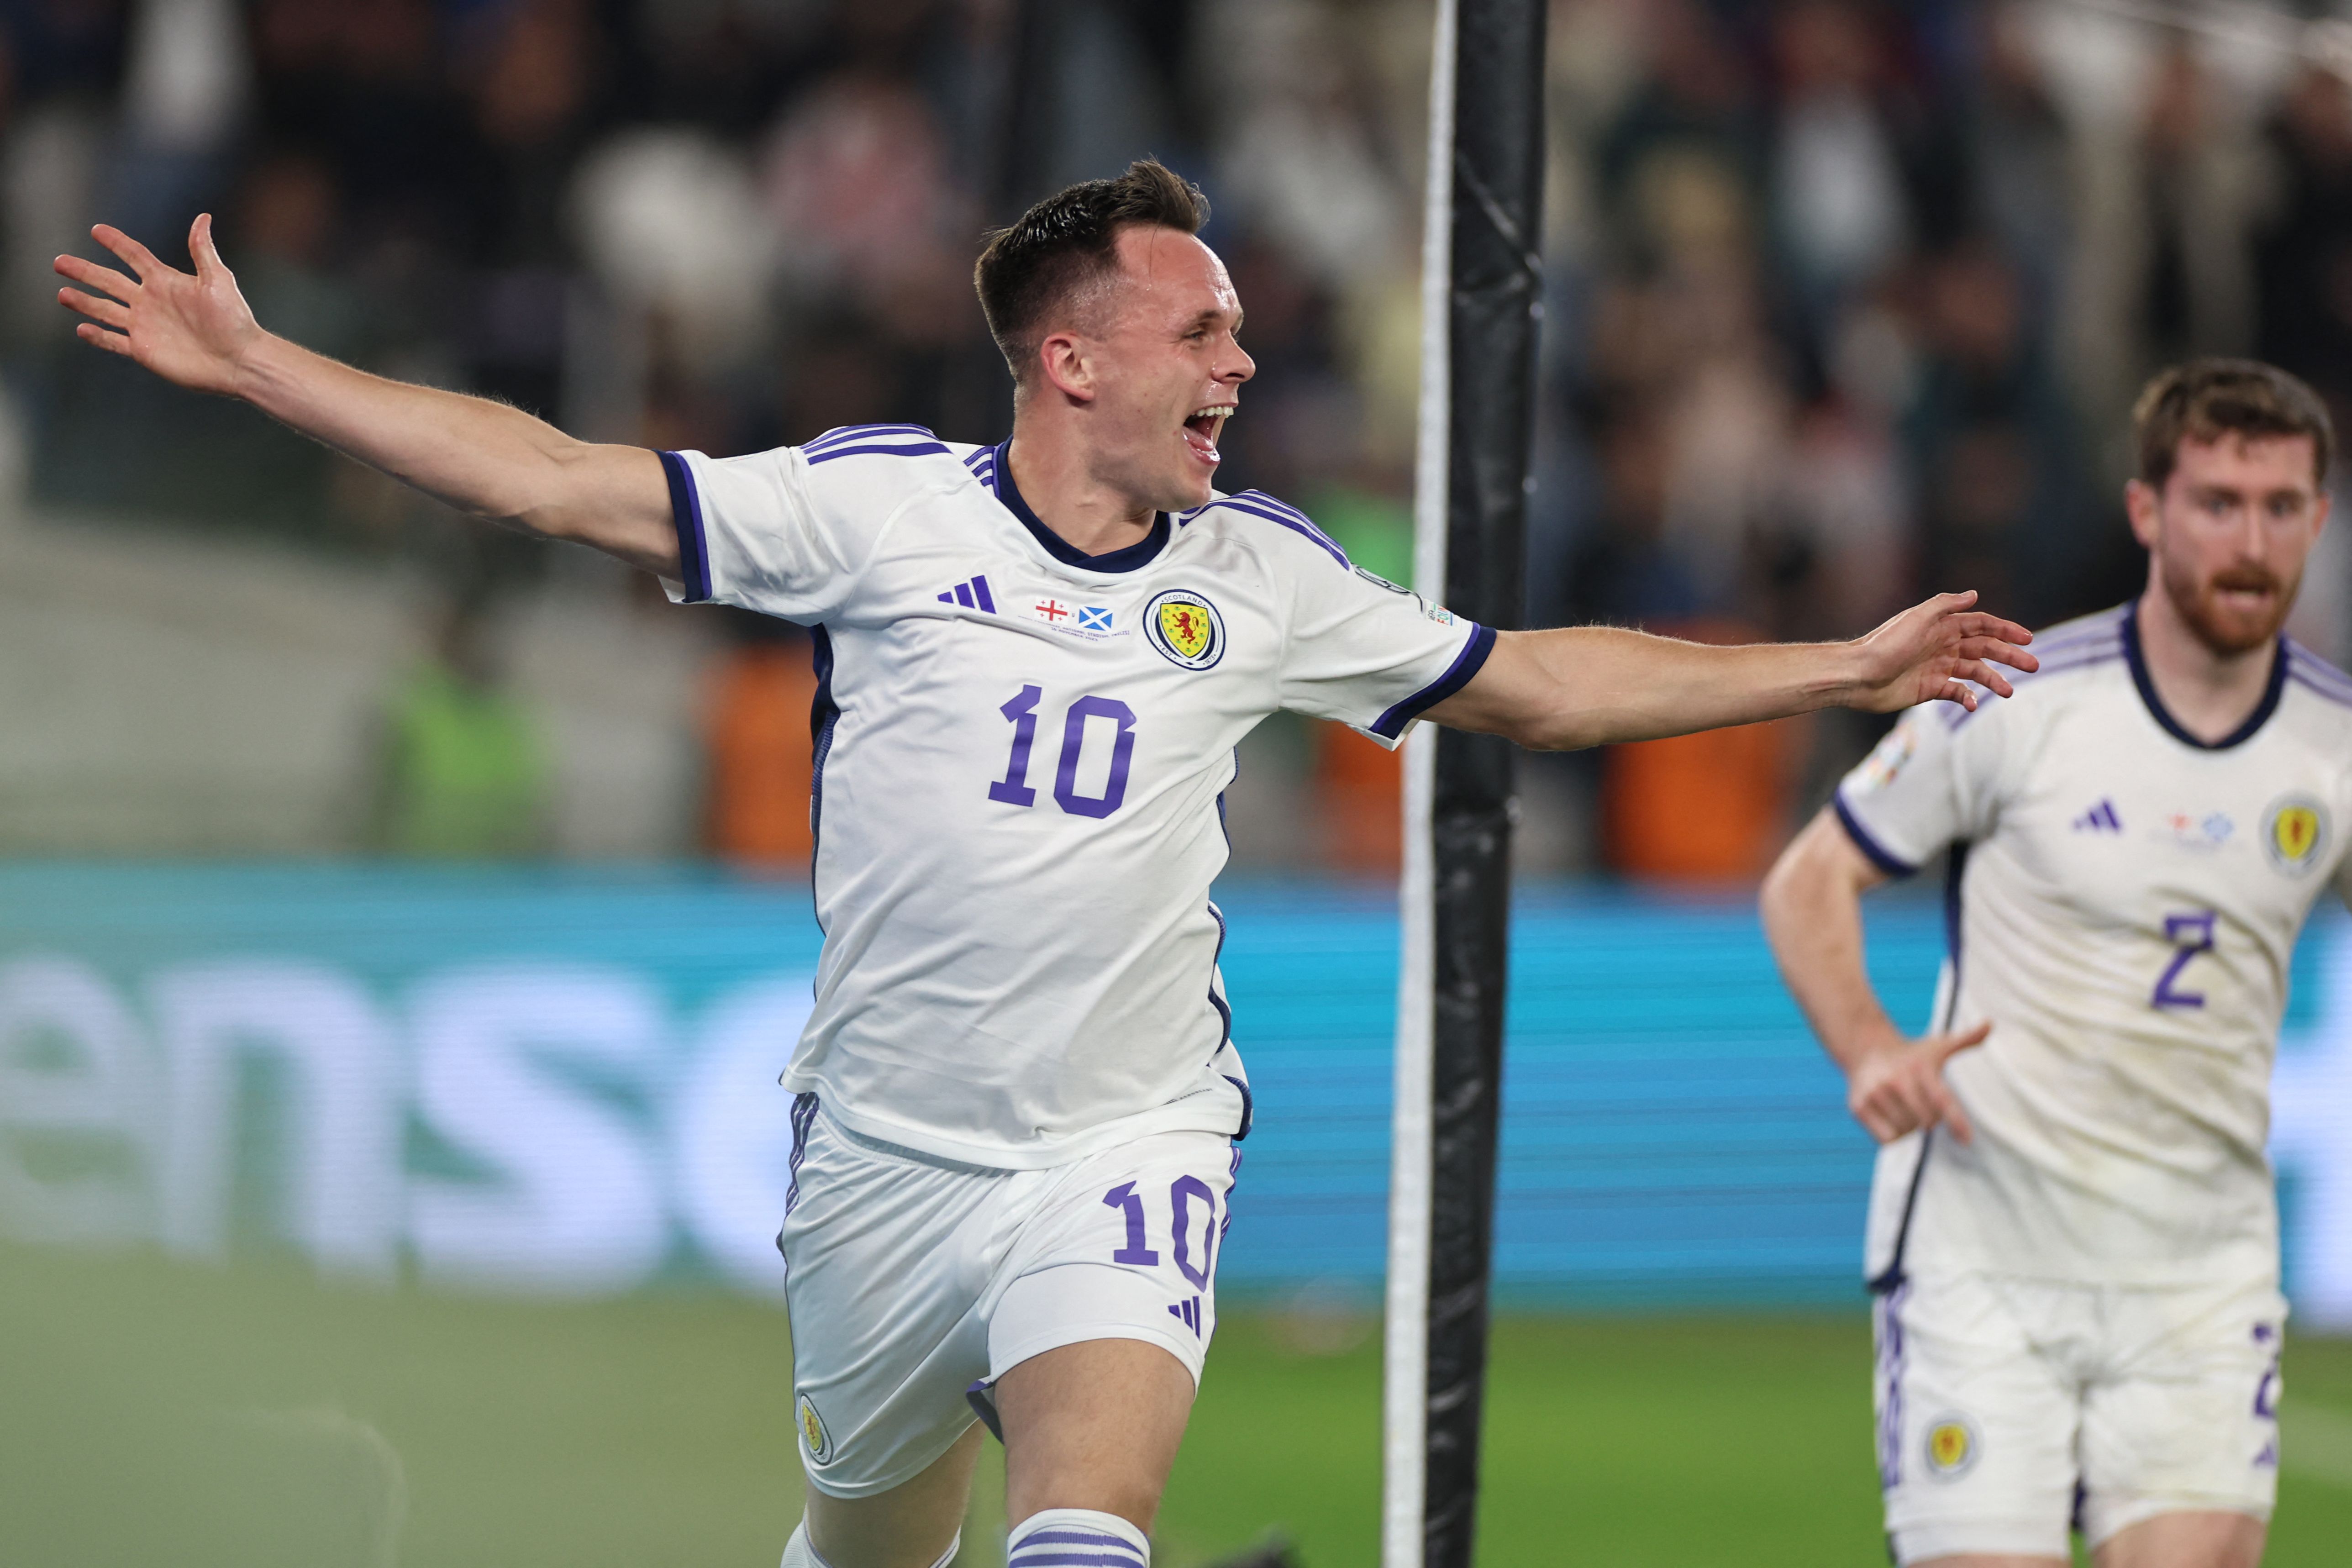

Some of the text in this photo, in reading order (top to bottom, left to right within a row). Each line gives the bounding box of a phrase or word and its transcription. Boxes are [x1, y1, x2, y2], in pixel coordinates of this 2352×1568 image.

[1164, 595, 1203, 605] SCOTLAND
[1162, 647, 1173, 657] EST
[1205, 655, 1215, 664] 1873
[988, 684, 1137, 819] 10
[2150, 911, 2217, 1008] 2
[1102, 1174, 1215, 1293] 10
